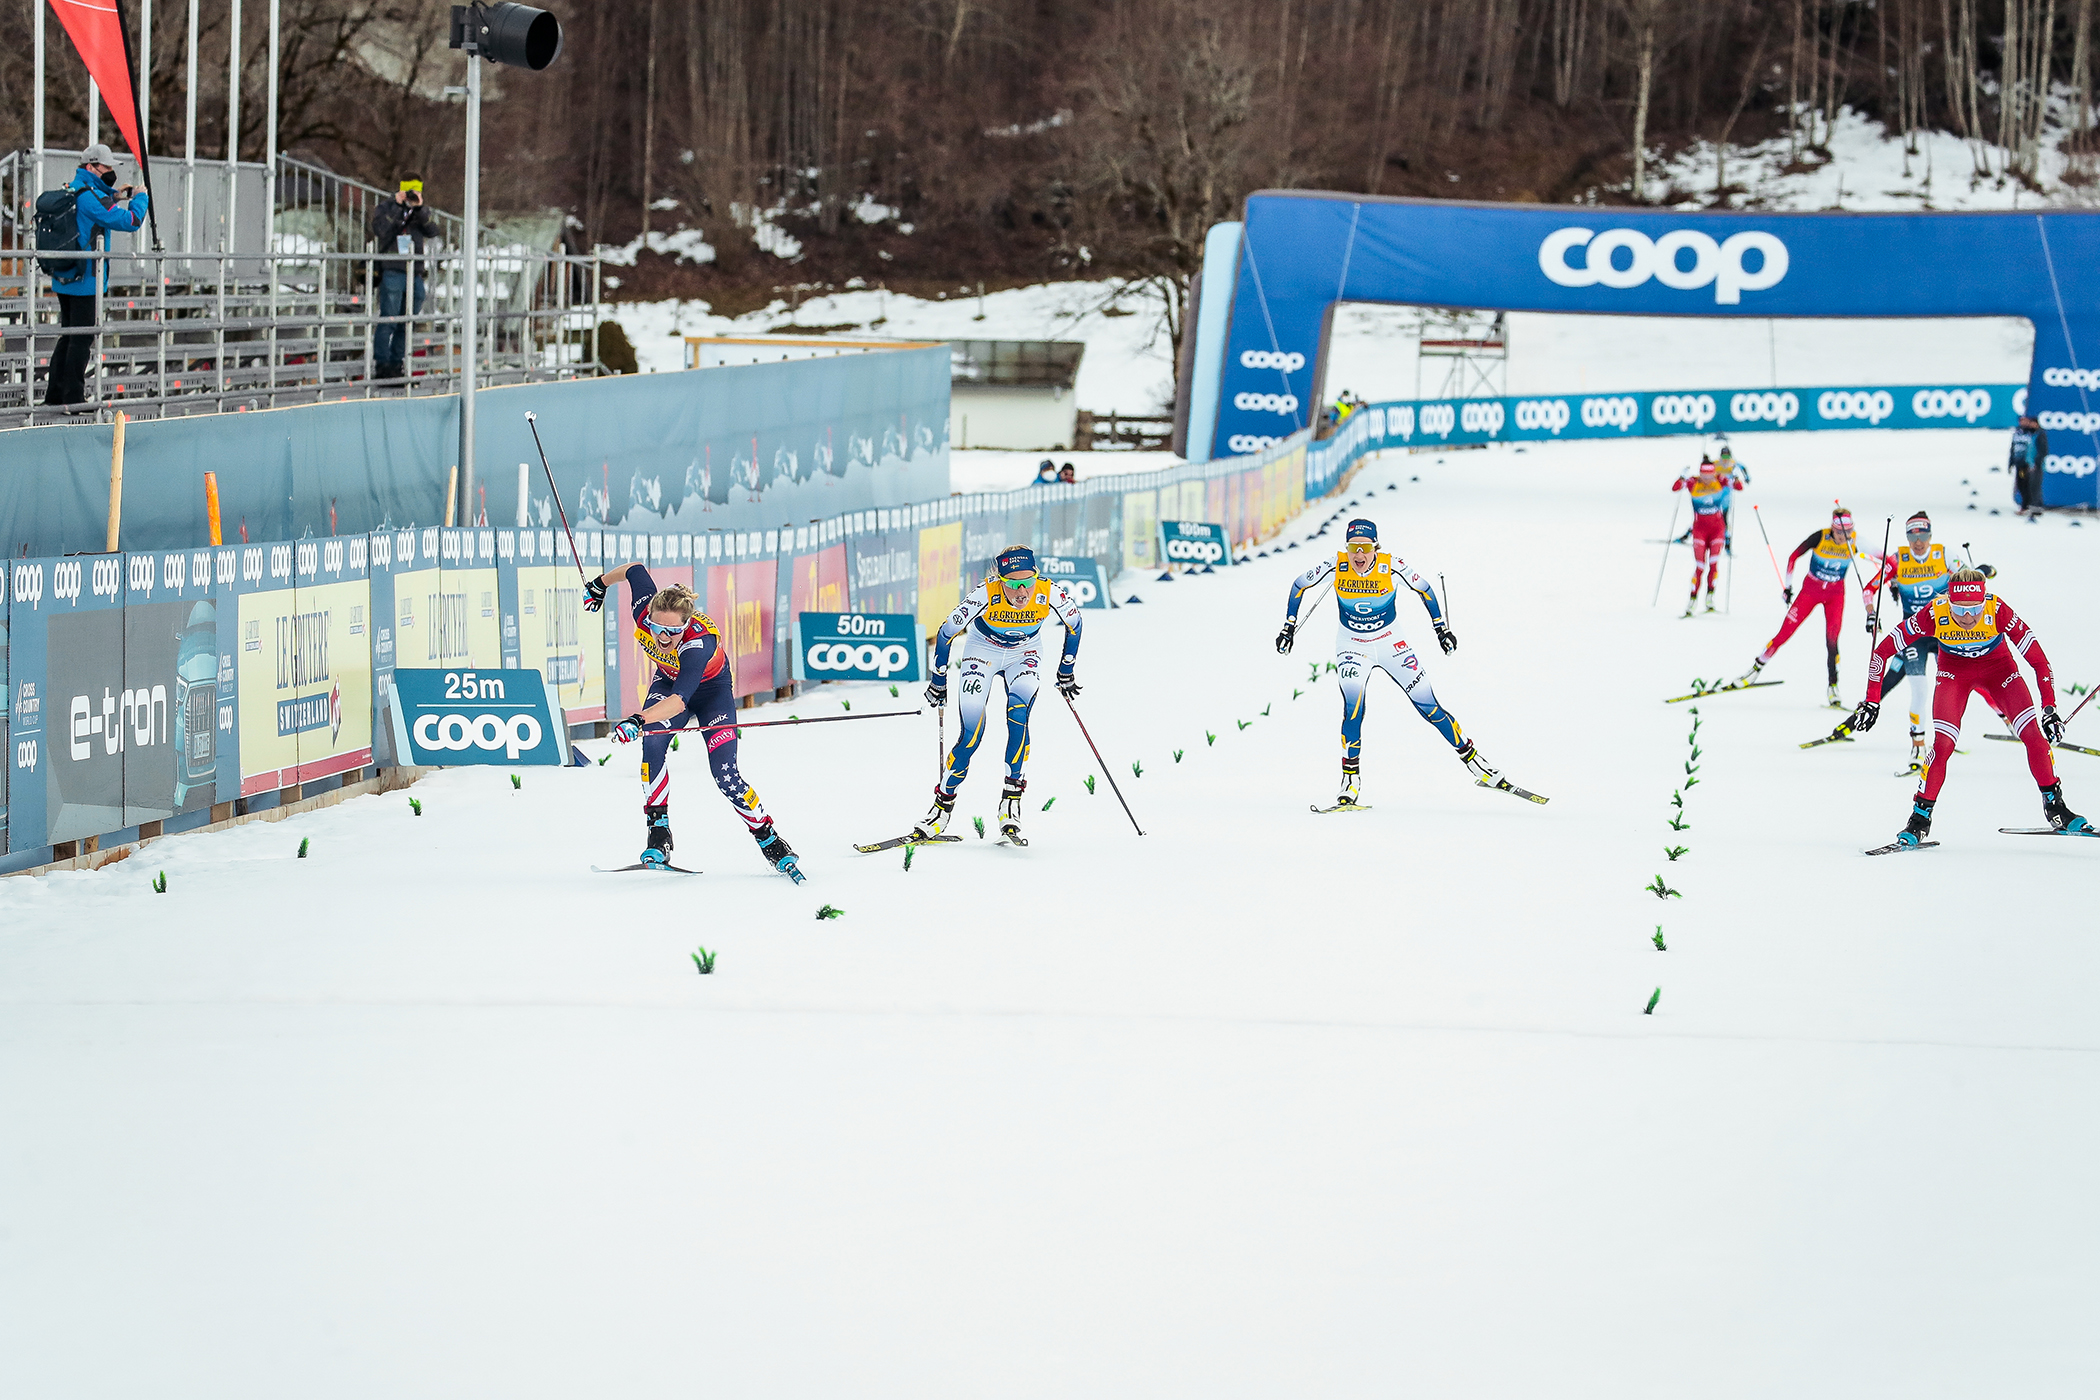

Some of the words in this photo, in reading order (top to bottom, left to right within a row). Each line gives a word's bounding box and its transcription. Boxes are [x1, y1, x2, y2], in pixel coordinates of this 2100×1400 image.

[1538, 227, 1789, 305] coop
[1240, 350, 1305, 374] coop
[1234, 392, 1298, 416] coop
[1461, 401, 1505, 438] coop
[1515, 400, 1570, 435] coop
[1581, 397, 1638, 432] coop
[1651, 394, 1716, 430] coop
[1731, 391, 1799, 427] coop
[1817, 388, 1894, 425] coop
[1912, 388, 1991, 423] coop
[2037, 411, 2100, 435] coop
[1228, 434, 1284, 452] coo
[2045, 454, 2097, 479] oop
[298, 543, 317, 582] coop
[324, 540, 343, 579] coop
[350, 537, 367, 575] coop
[372, 534, 391, 572] coop
[397, 531, 415, 568] coop
[422, 529, 438, 564] coop
[442, 530, 460, 566] coop
[1167, 539, 1223, 564] coop
[92, 559, 119, 603] coop
[130, 555, 155, 599] coop
[164, 553, 186, 596] coop
[192, 553, 211, 594] coop
[216, 550, 236, 591] coop
[243, 547, 263, 588] coop
[271, 545, 291, 584] coop
[1040, 557, 1075, 574] 75m
[15, 564, 43, 611] coop
[54, 561, 81, 607] coop
[1056, 579, 1097, 607] op
[1338, 579, 1346, 587] LE
[1347, 578, 1379, 588] GRUYÈRE
[1913, 585, 1934, 598] 19
[1953, 585, 1982, 593] LUKOIL
[836, 615, 885, 635] 50m
[989, 611, 998, 619] LE
[1000, 610, 1036, 619] GRUYÈRE
[1348, 620, 1384, 630] coop
[1354, 602, 1373, 614] 6
[276, 616, 288, 690] LE
[807, 643, 909, 678] coop
[444, 672, 505, 699] 25m
[962, 670, 985, 678] SCANIA
[962, 678, 982, 695] life
[1341, 667, 1359, 679] life
[1405, 671, 1425, 693] CRAFT
[1936, 671, 1955, 680] UKOIL
[70, 684, 166, 761] e-tron
[219, 705, 233, 735] coop
[279, 698, 328, 731] SWITZERLAND
[708, 713, 728, 727] swix
[413, 714, 542, 760] coop
[708, 729, 734, 750] xfinity
[17, 740, 38, 773] coop
